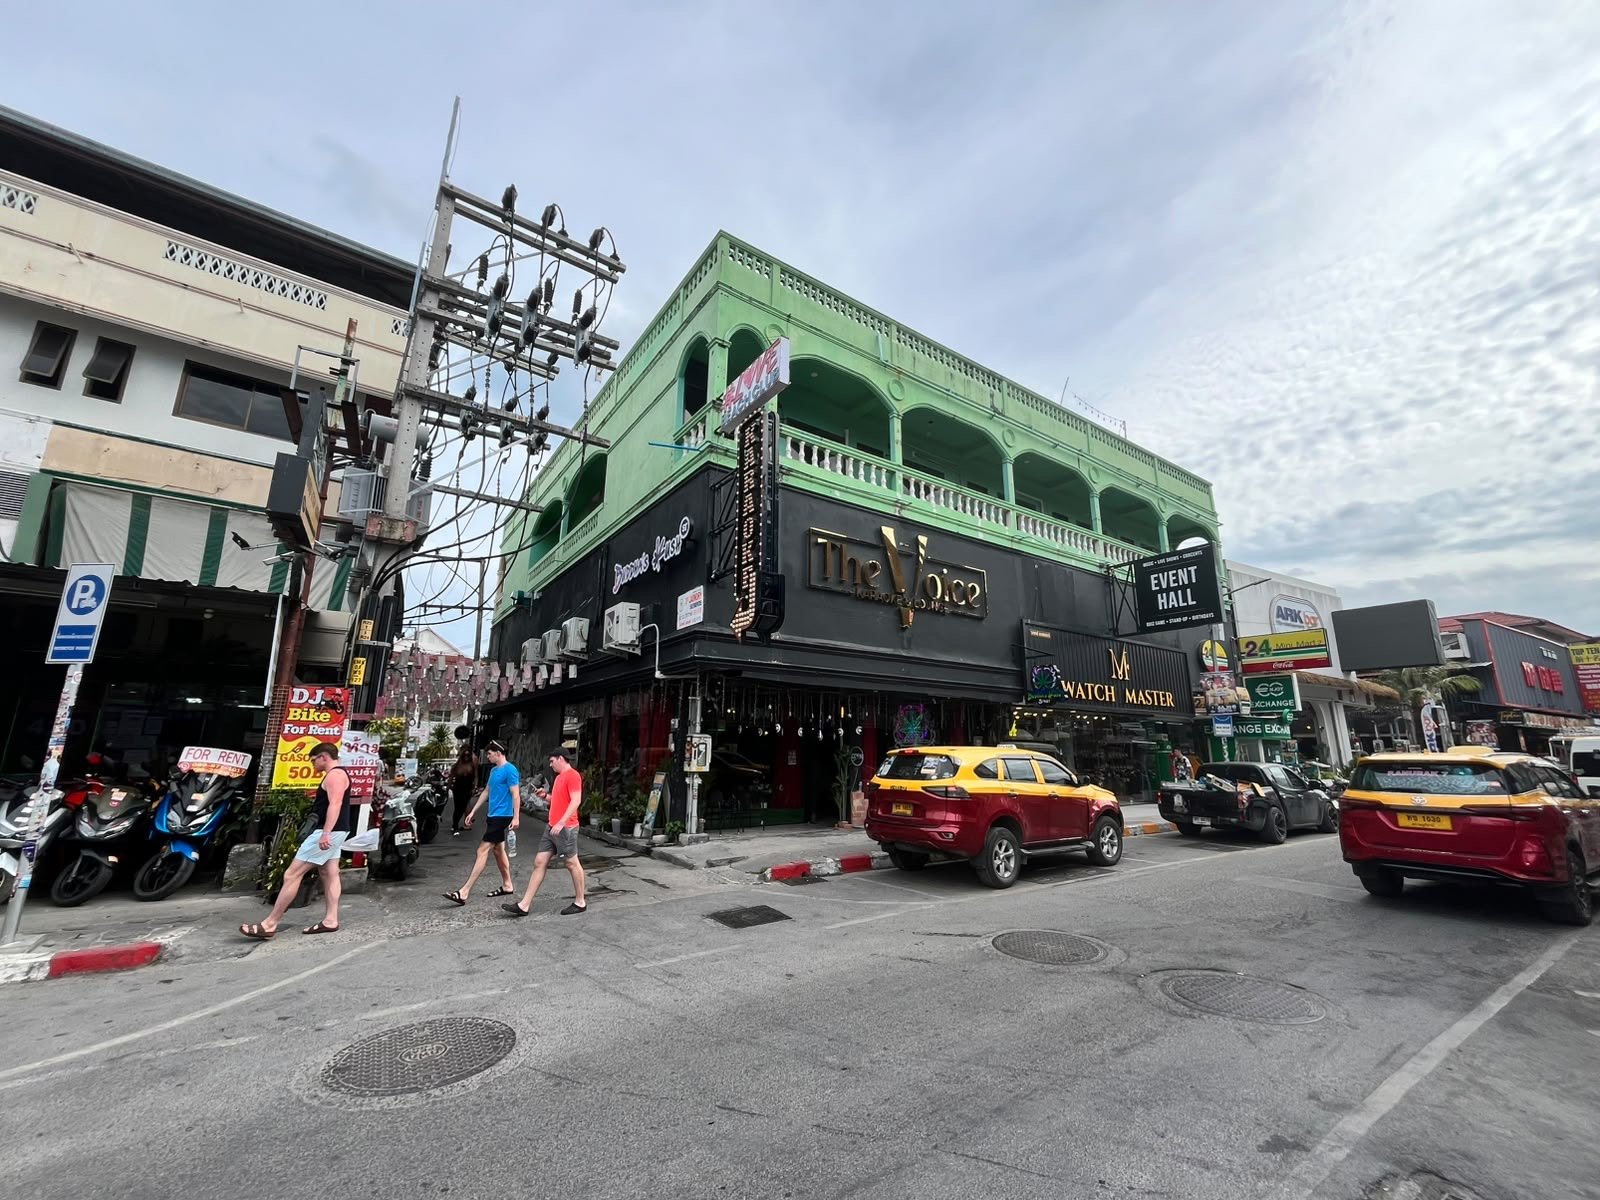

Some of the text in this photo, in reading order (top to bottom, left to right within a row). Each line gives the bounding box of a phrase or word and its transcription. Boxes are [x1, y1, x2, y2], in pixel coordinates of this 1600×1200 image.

[742, 420, 757, 589] KARAOKE
[817, 525, 981, 608] The Voice
[1150, 566, 1197, 591] EVENT
[1157, 588, 1197, 610] HALL
[1276, 605, 1304, 624] ARK
[1245, 638, 1272, 657] 24
[1272, 660, 1294, 669] Coca-Cola
[291, 688, 326, 705] DJ.
[1061, 680, 1116, 702] WATCH
[1125, 687, 1175, 707] MASTER
[1250, 699, 1295, 708] EXCHANGE
[287, 707, 331, 722] Bike
[283, 723, 341, 735] For Rent
[184, 748, 248, 766] FOR RENT
